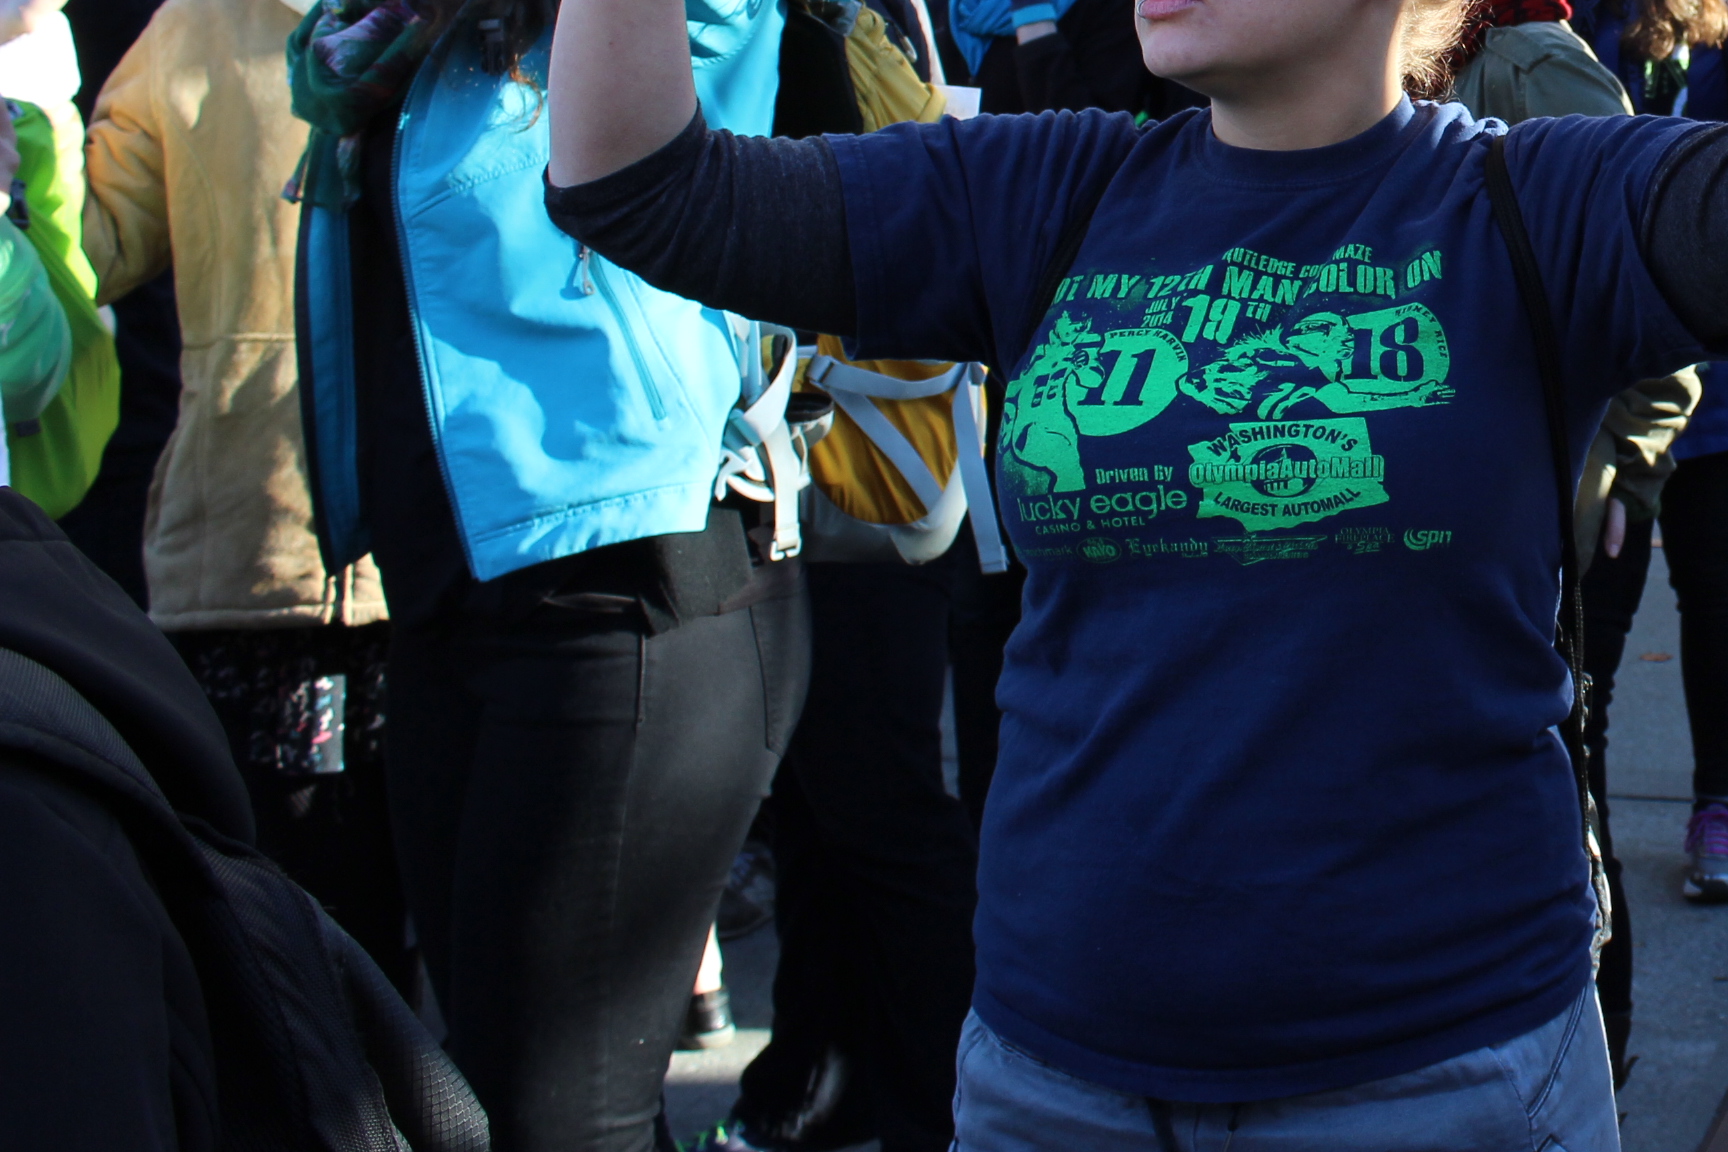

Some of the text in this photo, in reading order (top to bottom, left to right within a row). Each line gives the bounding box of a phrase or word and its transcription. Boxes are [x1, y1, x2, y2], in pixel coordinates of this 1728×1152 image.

[1222, 247, 1296, 277] RUTLEDGE
[1333, 244, 1374, 262] MAZE
[1086, 274, 1142, 299] MY
[1147, 264, 1214, 298] 12TH
[1221, 266, 1303, 306] MAN
[1407, 250, 1443, 289] ON
[1141, 311, 1174, 328] 2014
[1145, 296, 1181, 315] JULY
[1109, 330, 1188, 363] PERCY HARVIN
[1343, 317, 1425, 382] 18
[1077, 348, 1157, 407] 11
[1206, 423, 1359, 457] WASHINGTON'S
[1095, 464, 1174, 485] Driven By
[1017, 485, 1188, 522] lucky eagle
[1214, 487, 1362, 517] LARGEST AUTOMALL
[1035, 516, 1146, 535] CASINO & HOTEL
